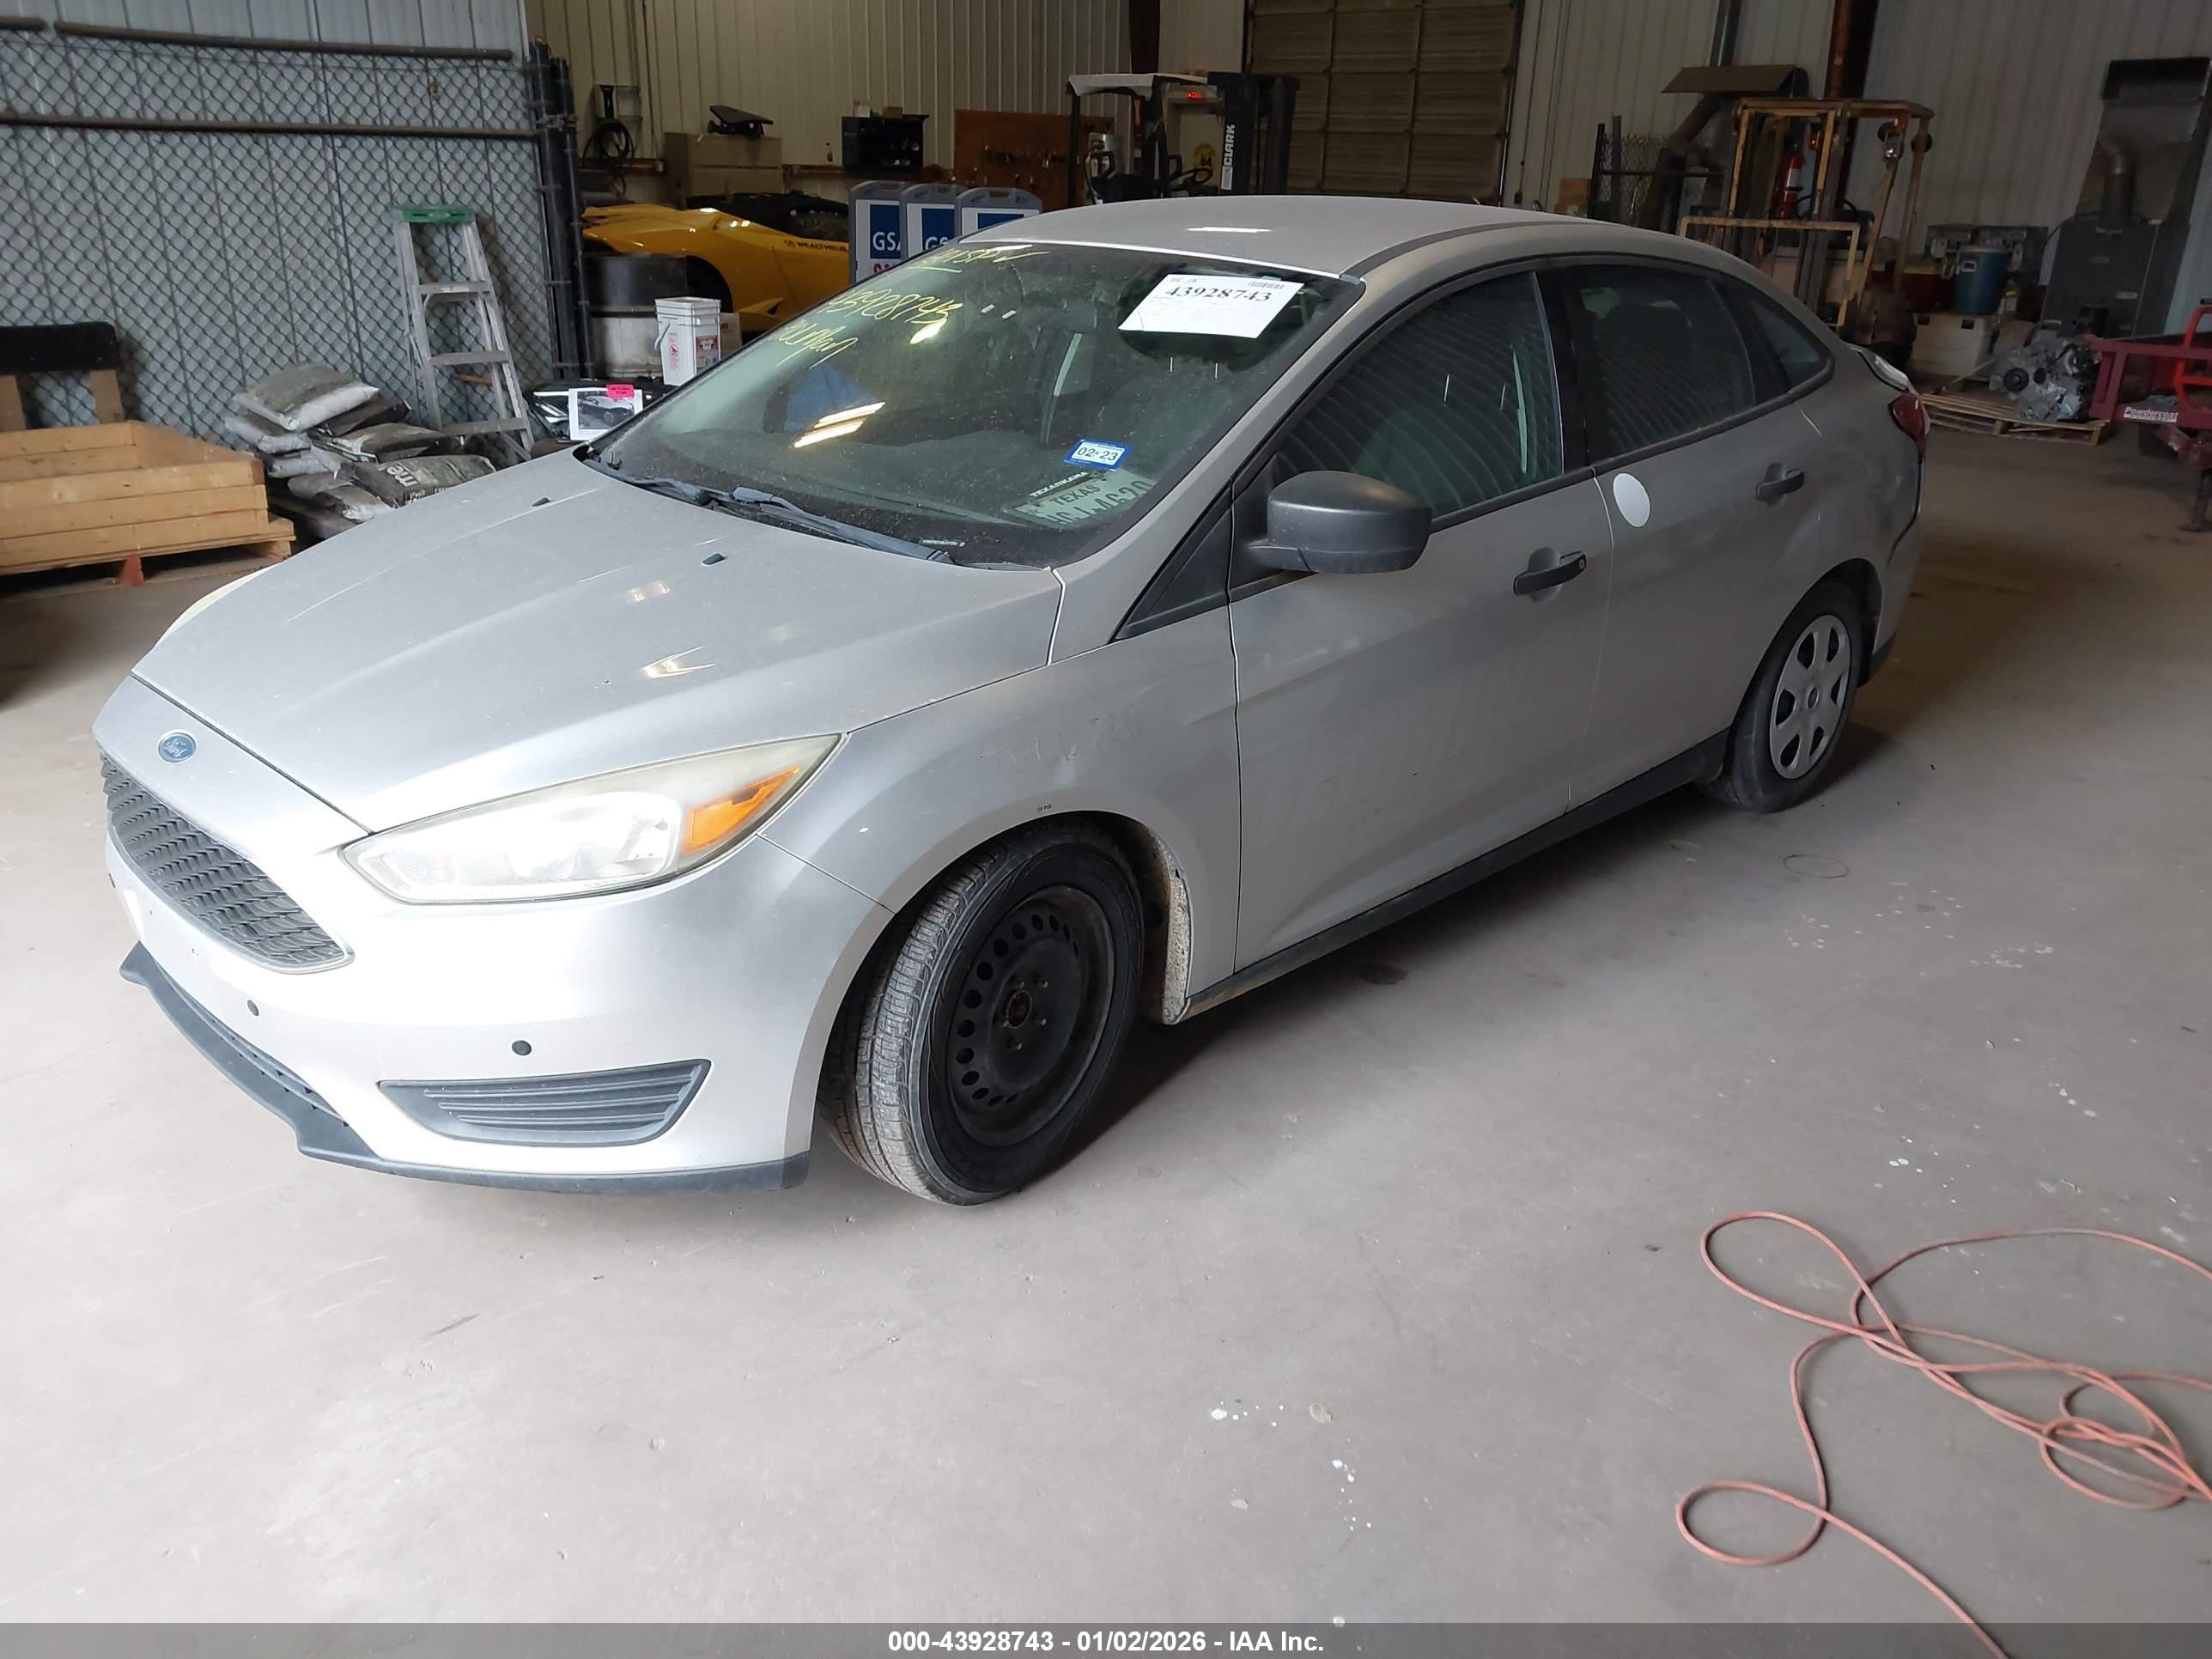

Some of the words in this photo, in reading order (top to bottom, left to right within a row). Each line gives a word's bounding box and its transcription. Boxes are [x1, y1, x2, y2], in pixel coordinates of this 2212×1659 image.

[1224, 125, 1235, 165] CLARK
[1166, 286, 1273, 301] 43928743
[1077, 447, 1096, 458] 02
[1100, 450, 1119, 461] 23
[1049, 484, 1102, 506] TEXAS
